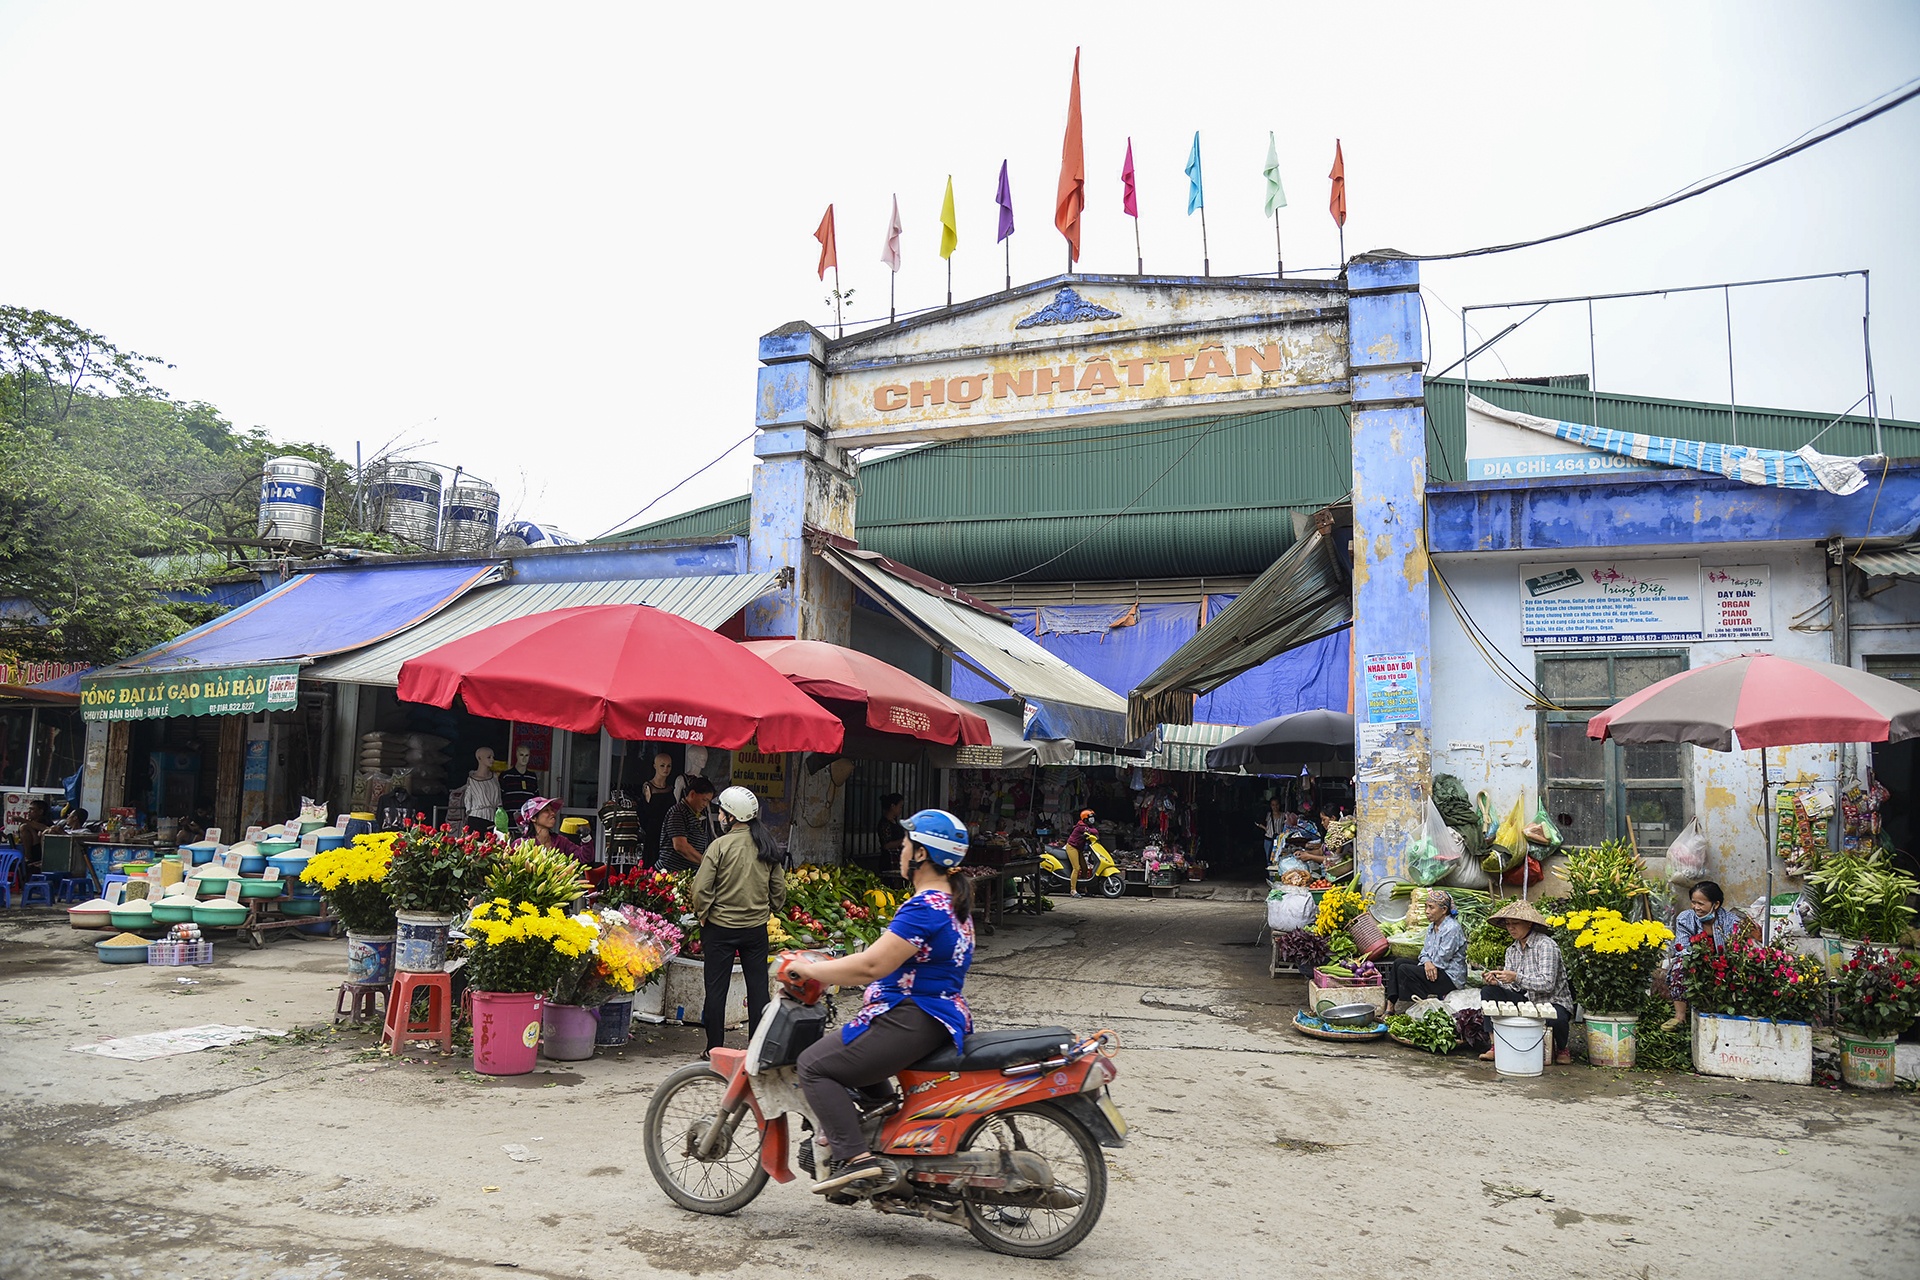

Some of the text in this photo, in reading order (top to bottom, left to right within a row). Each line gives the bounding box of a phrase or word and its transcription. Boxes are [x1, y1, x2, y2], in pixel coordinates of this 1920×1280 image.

[873, 342, 1282, 411] CHỢ NHẬT TÂN
[1483, 461, 1512, 478] ĐỊA
[1516, 456, 1551, 474] CHỈ:
[1554, 458, 1585, 471] 464
[1602, 582, 1666, 597] Trùng Điệp
[1718, 591, 1734, 599] DẠY
[1721, 600, 1750, 608] ORGAN
[1722, 618, 1752, 626] GUITAR
[81, 675, 267, 707] TỔNG ĐẠI LÝ GẠO HẢI HẬU
[83, 709, 109, 720] CHUYÊN
[108, 707, 124, 719] BÁN
[124, 707, 144, 718] BUÔN
[147, 705, 160, 717] BÁN
[654, 710, 668, 723] TỐT
[667, 712, 683, 726] ĐỘC
[657, 727, 675, 738] 0967
[690, 730, 704, 742] 234
[738, 749, 765, 764] QUẦN
[756, 771, 769, 780] THAY
